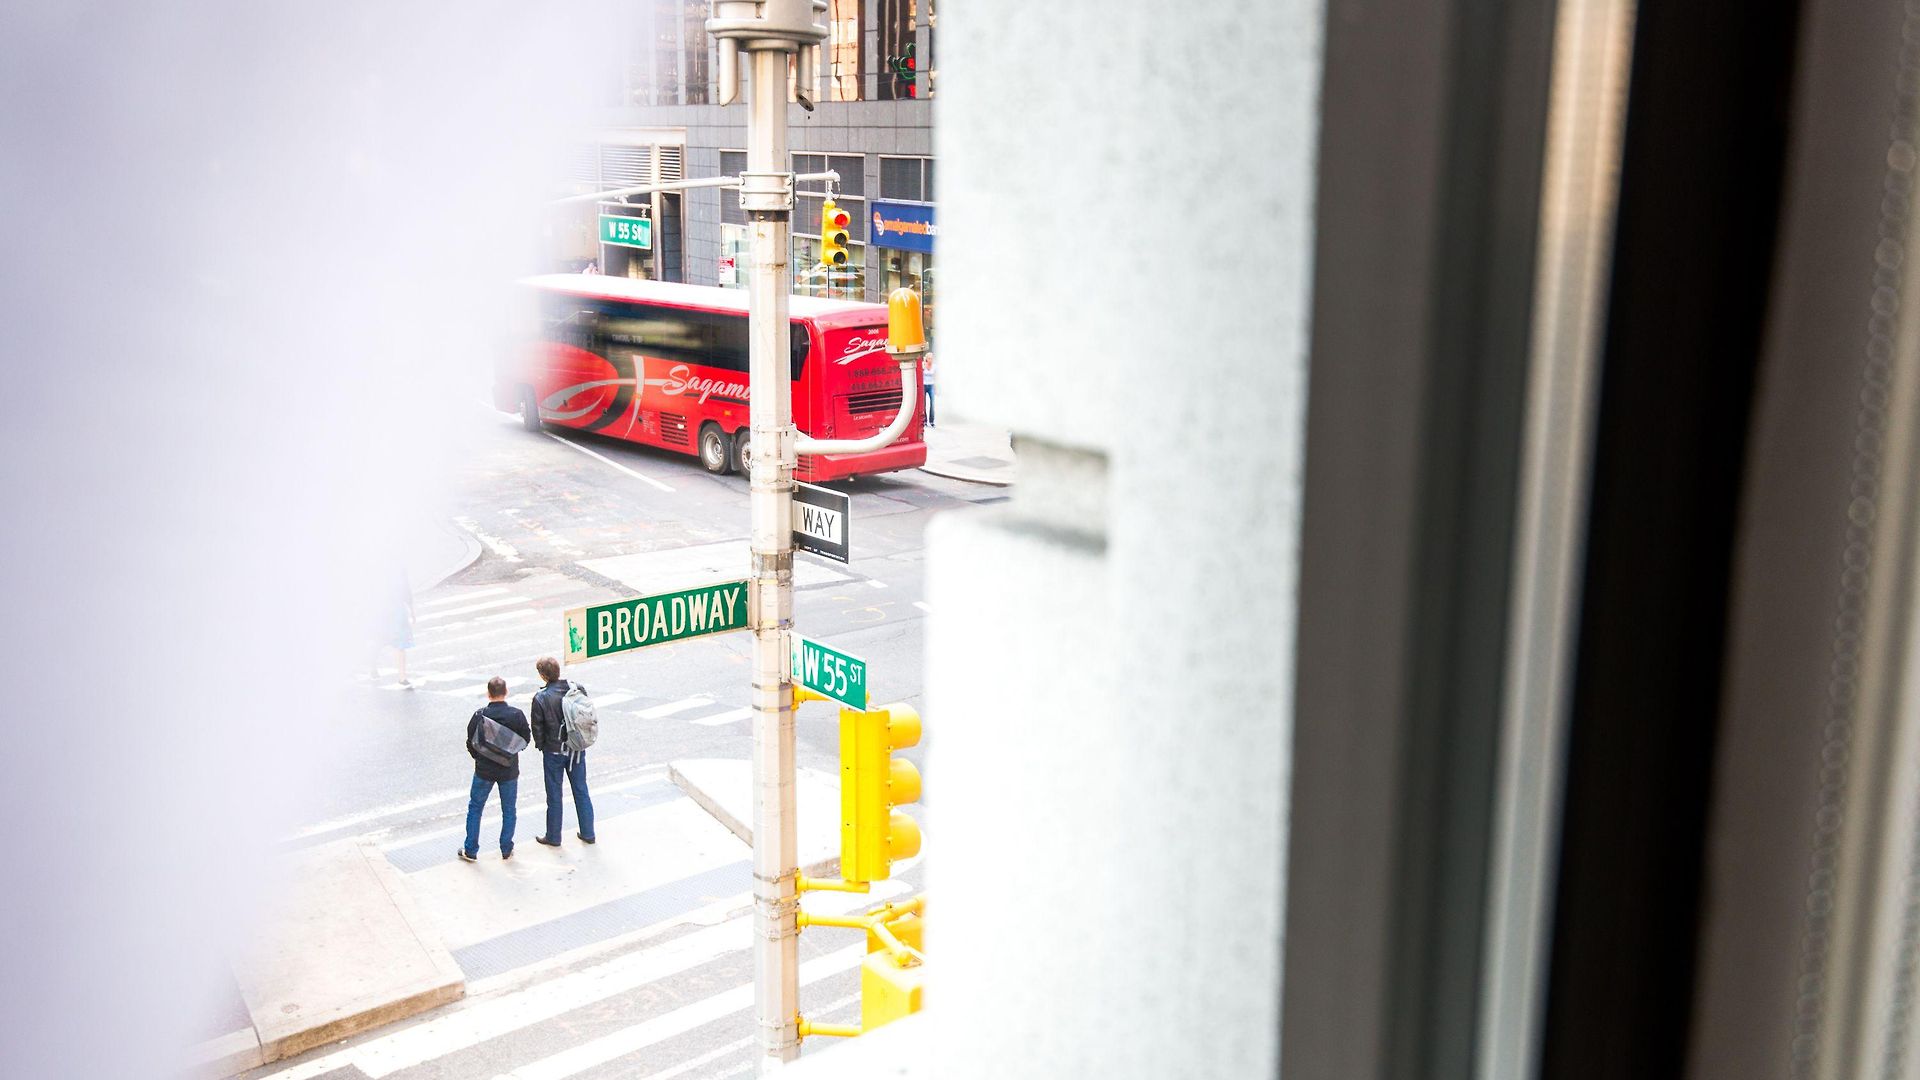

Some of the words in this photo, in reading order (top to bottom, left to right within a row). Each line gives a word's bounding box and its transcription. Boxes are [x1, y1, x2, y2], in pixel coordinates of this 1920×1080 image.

[608, 221, 616, 238] W
[618, 222, 630, 240] 55
[803, 506, 834, 538] WAY
[598, 587, 740, 650] BROADWAY
[803, 644, 820, 686] W
[823, 652, 848, 697] 55
[849, 662, 863, 686] ST
